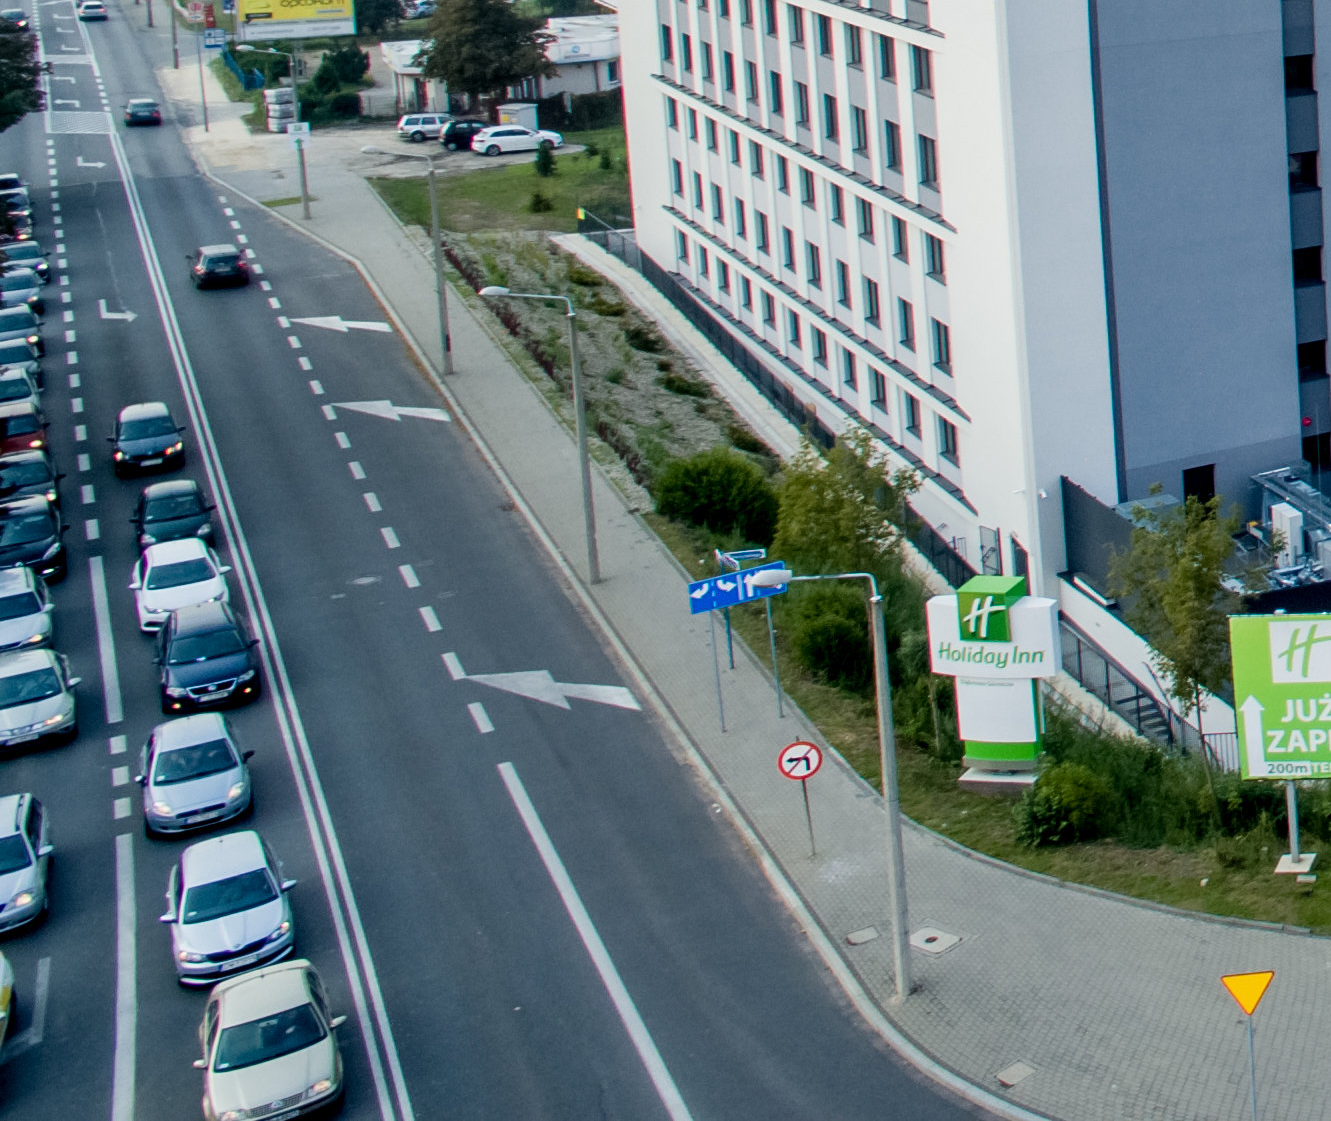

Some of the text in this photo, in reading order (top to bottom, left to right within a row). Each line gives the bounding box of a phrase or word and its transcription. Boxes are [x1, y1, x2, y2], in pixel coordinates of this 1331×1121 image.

[938, 641, 1046, 669] Holiday Inn
[1267, 762, 1308, 774] 200m
